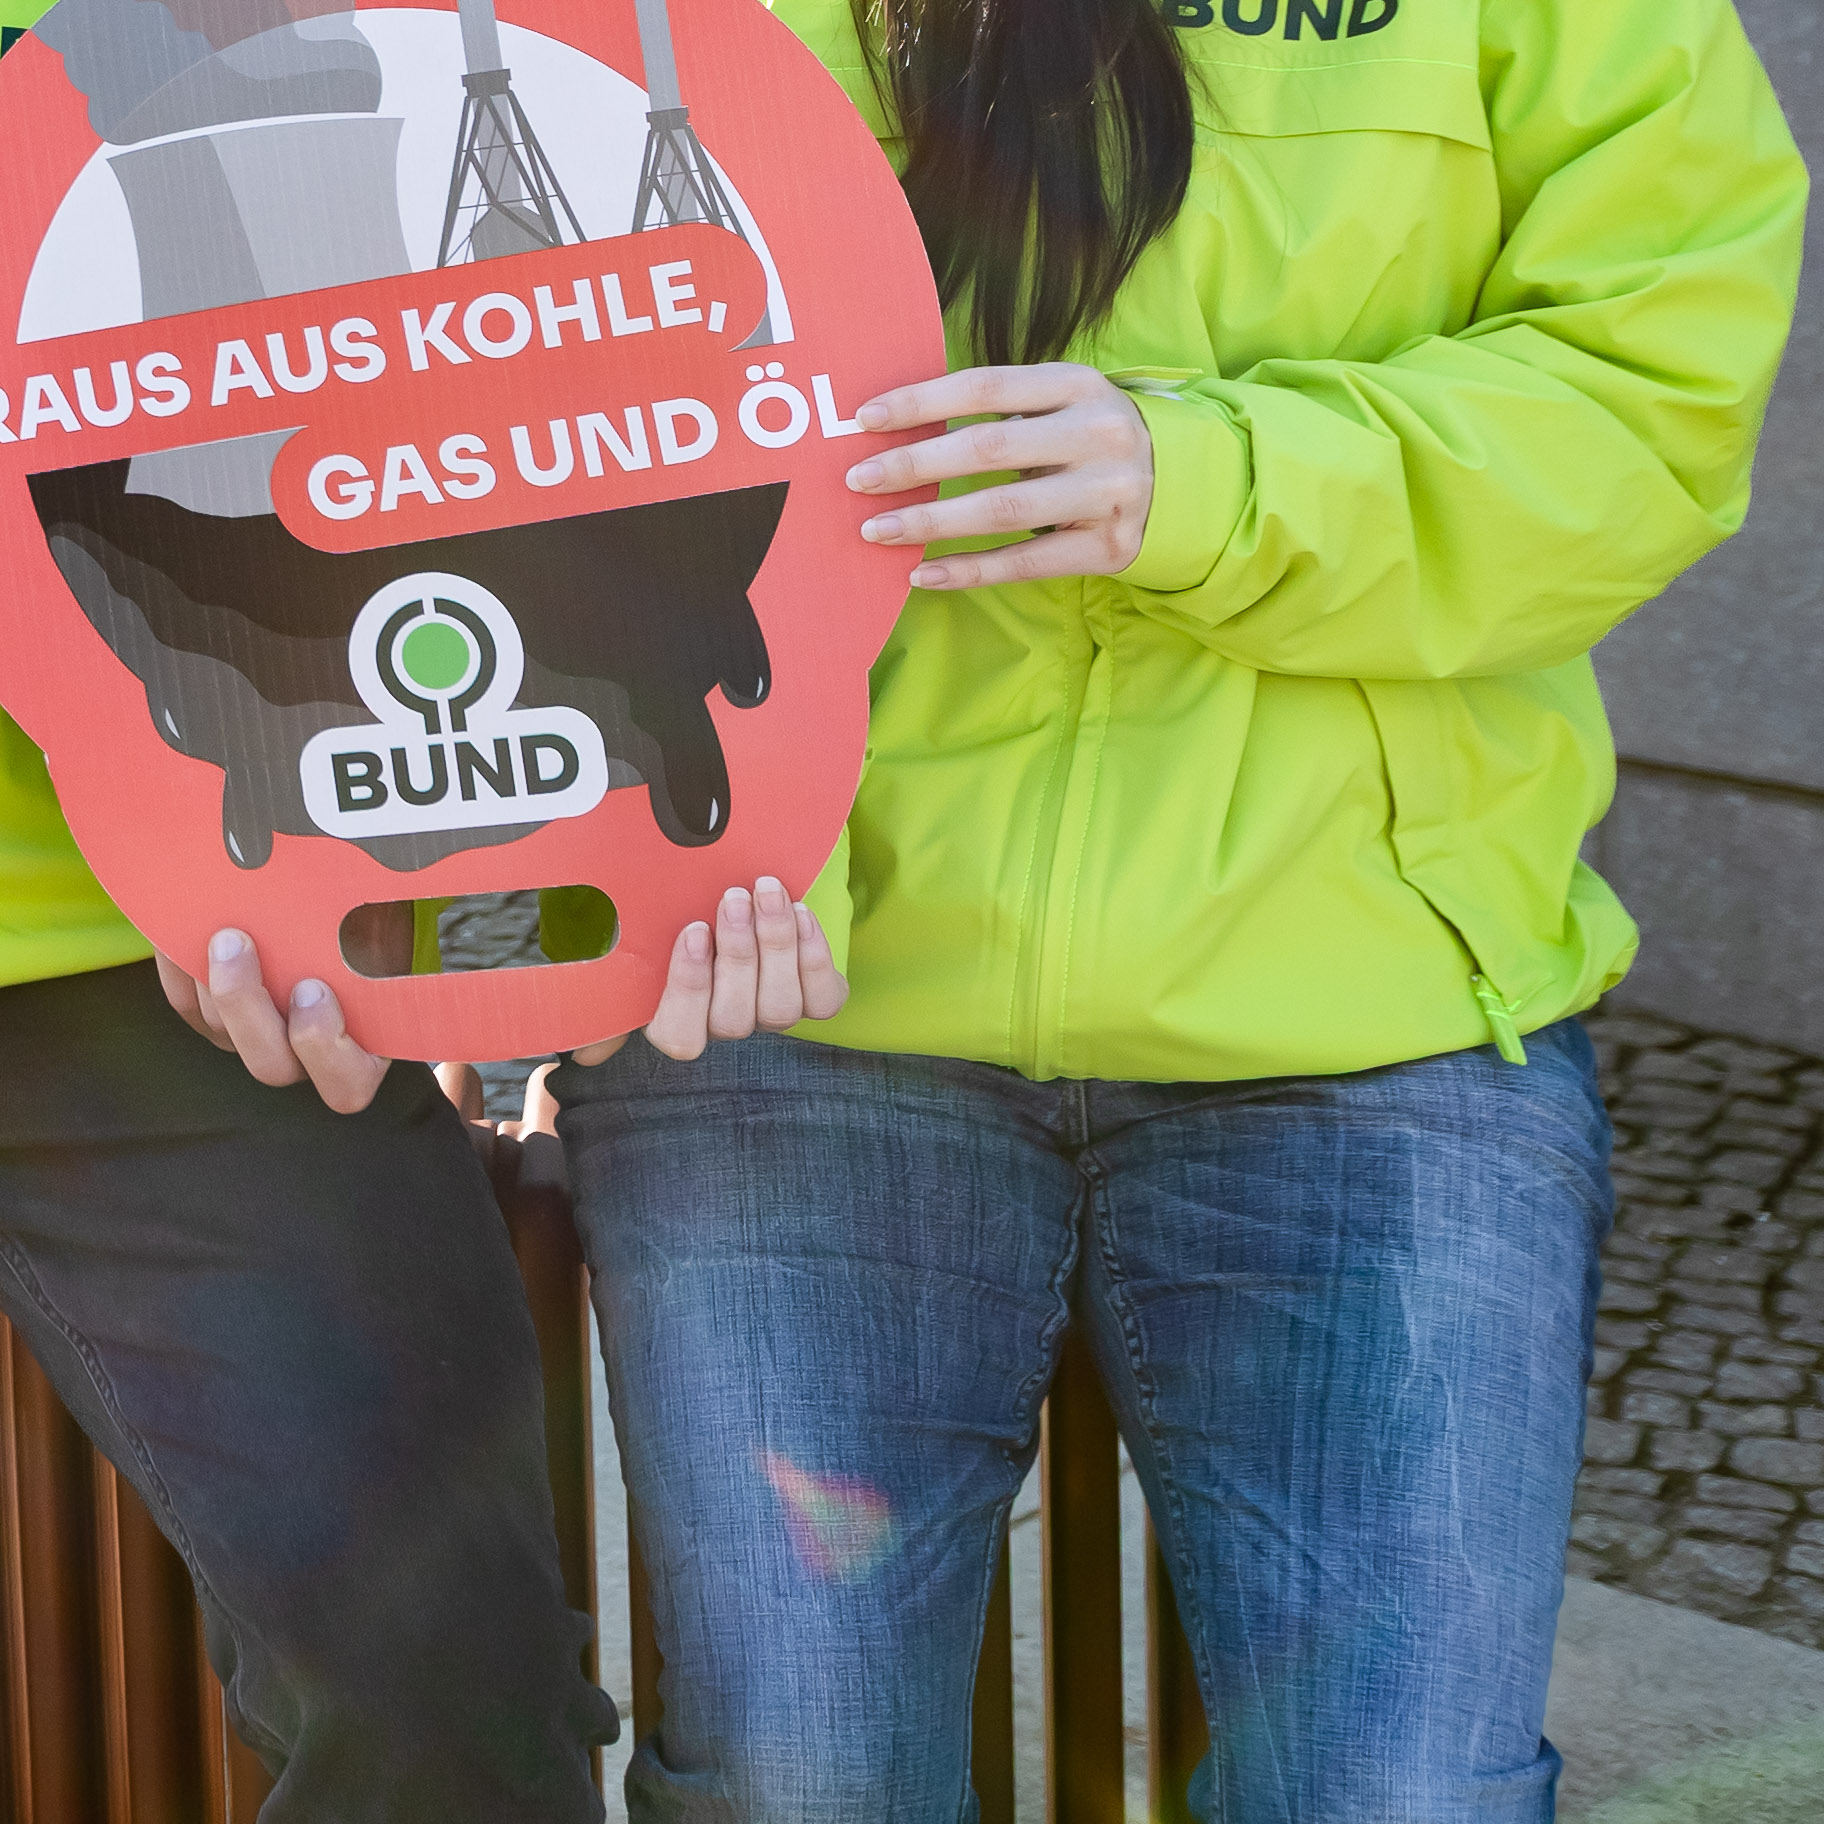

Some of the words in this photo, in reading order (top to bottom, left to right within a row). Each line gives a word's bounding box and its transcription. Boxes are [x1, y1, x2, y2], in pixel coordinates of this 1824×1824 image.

[210, 317, 387, 407] AUS
[400, 259, 729, 373] KOHLE,
[307, 433, 497, 522] GAS
[509, 397, 719, 488] UND
[737, 360, 866, 449] ÖL
[329, 731, 582, 814] BUND
